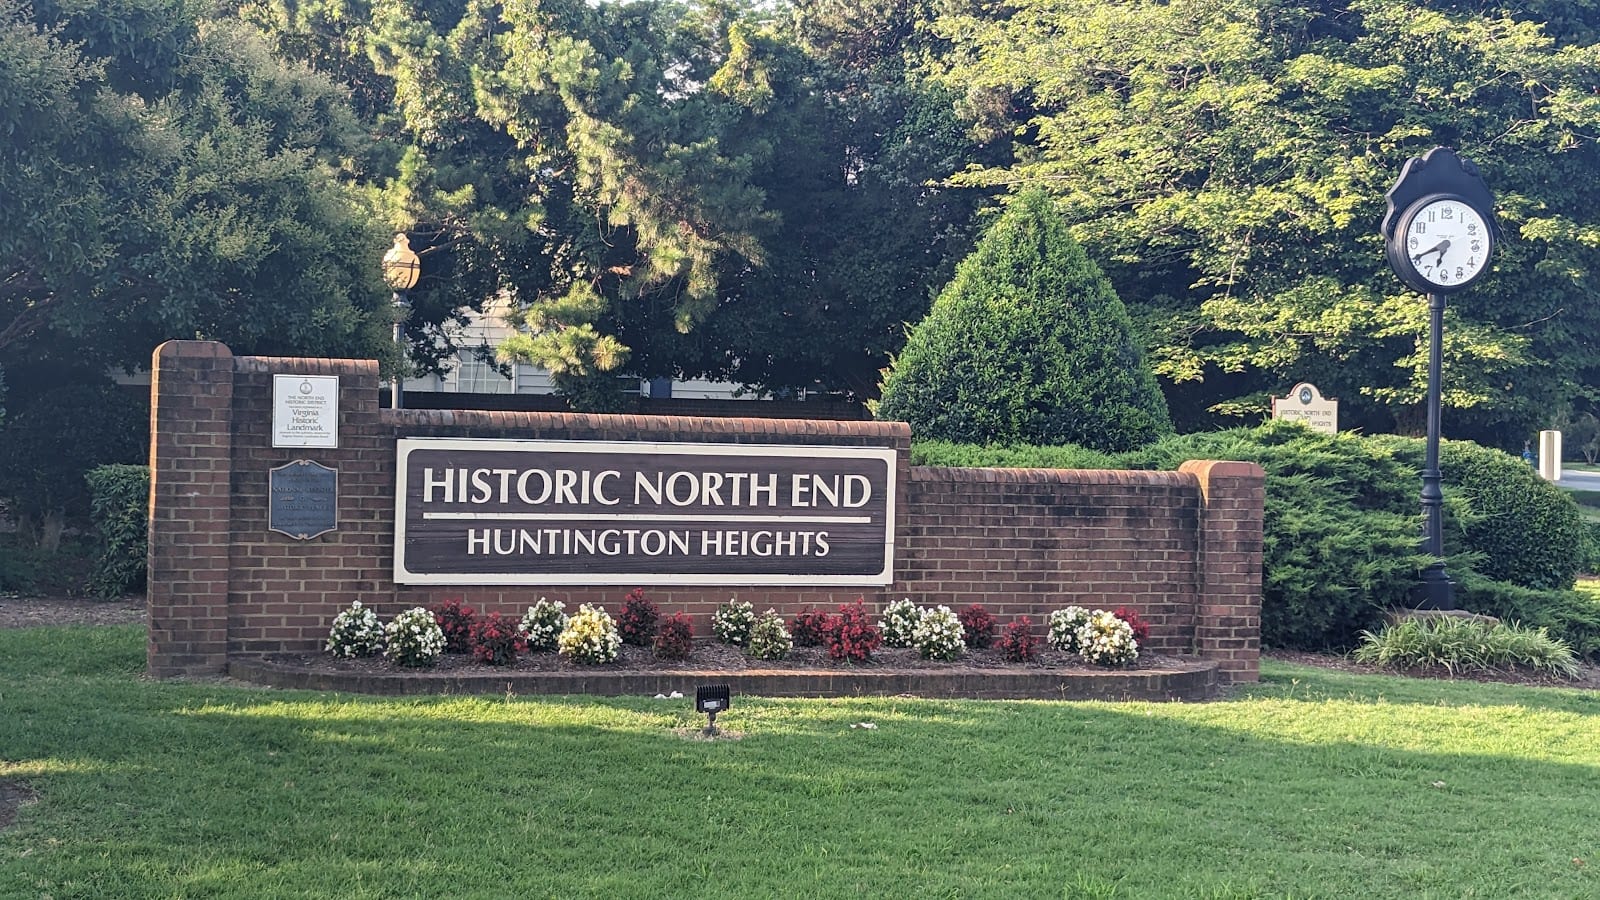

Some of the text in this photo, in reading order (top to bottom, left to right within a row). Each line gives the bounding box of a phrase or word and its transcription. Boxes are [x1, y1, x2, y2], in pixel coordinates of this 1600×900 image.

[1428, 211, 1435, 222] 11
[1441, 207, 1453, 219] 12
[1416, 222, 1426, 234] 10
[1467, 223, 1478, 235] 2
[1410, 236, 1418, 249] 9
[1471, 240, 1480, 252] 3
[1467, 256, 1475, 268] 4
[1424, 265, 1432, 277] 7
[1440, 269, 1448, 282] 6
[1456, 267, 1463, 279] 5
[292, 409, 319, 418] Virginia
[423, 467, 872, 508] HISTORIC NORTH END
[467, 528, 830, 557] HUNTINGTON HEIGHTS
